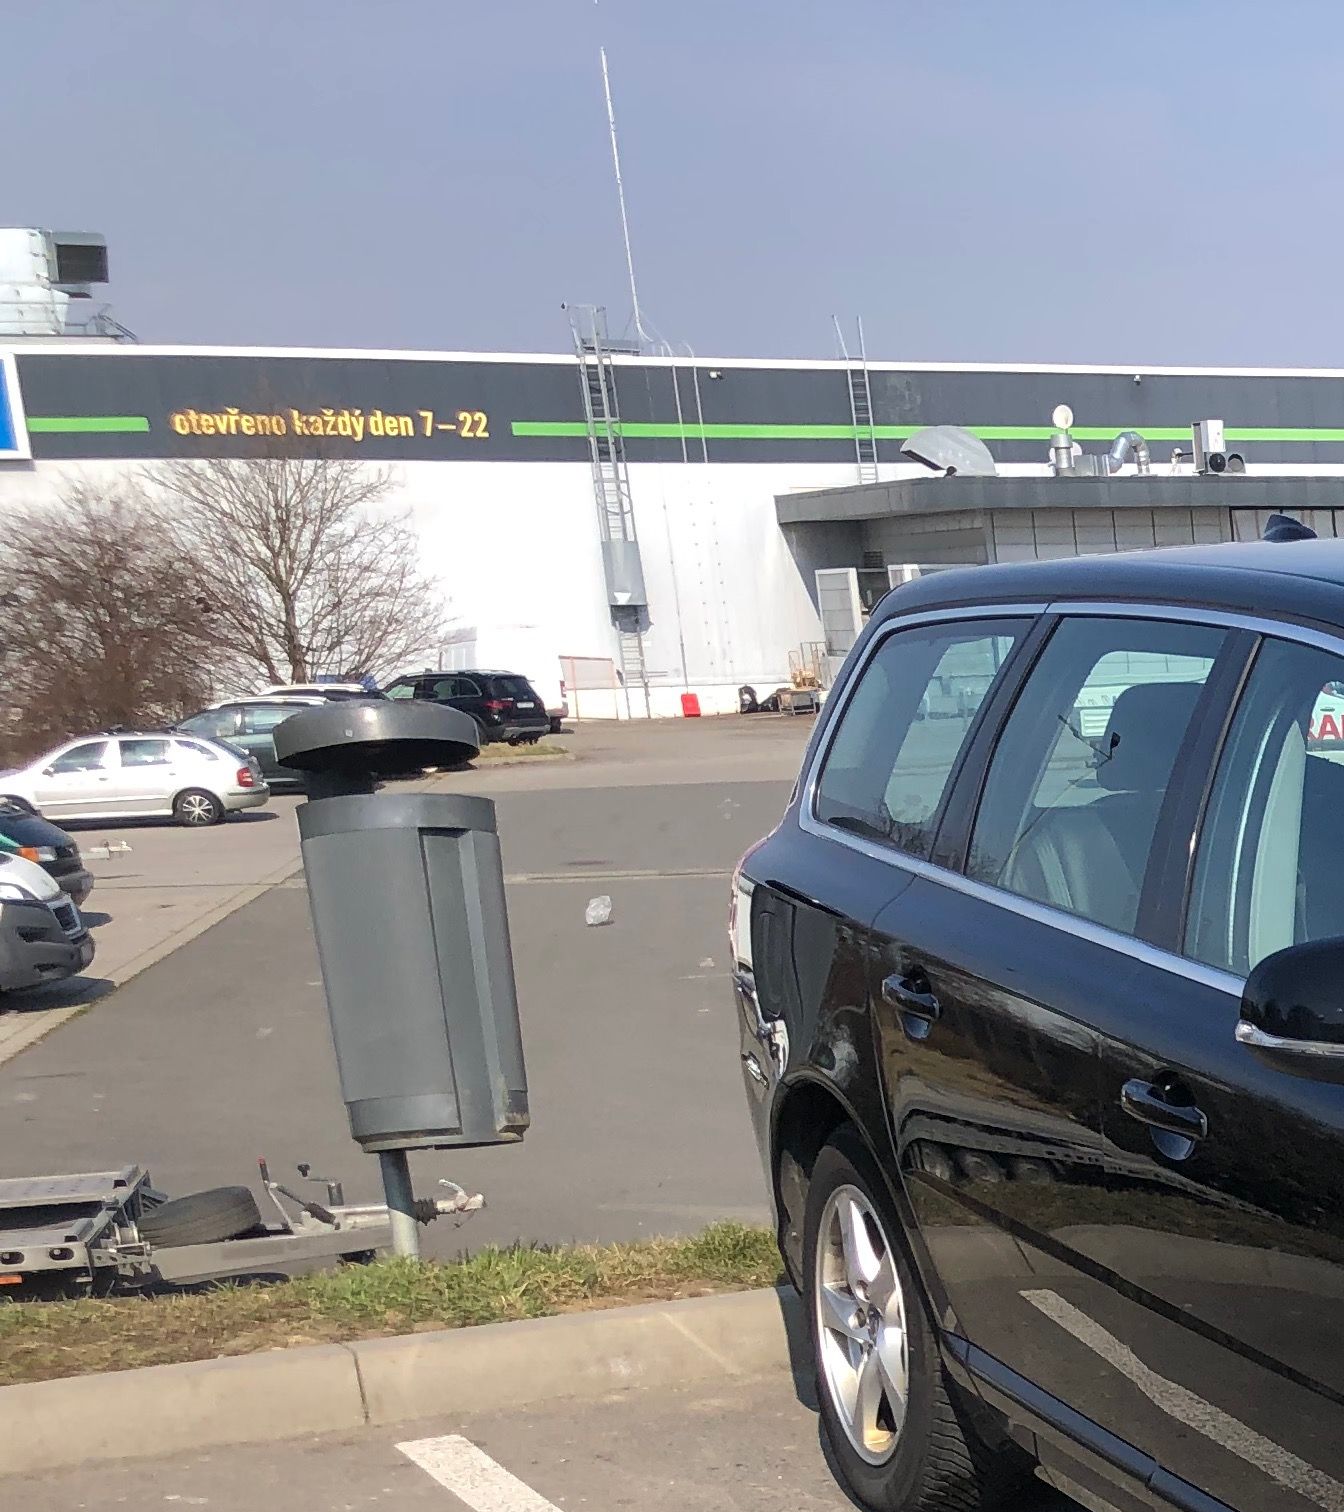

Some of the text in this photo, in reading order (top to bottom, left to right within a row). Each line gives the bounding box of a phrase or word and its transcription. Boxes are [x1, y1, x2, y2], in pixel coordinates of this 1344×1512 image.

[172, 406, 287, 436] otevřeno
[291, 406, 365, 441] každý
[368, 409, 415, 438] den
